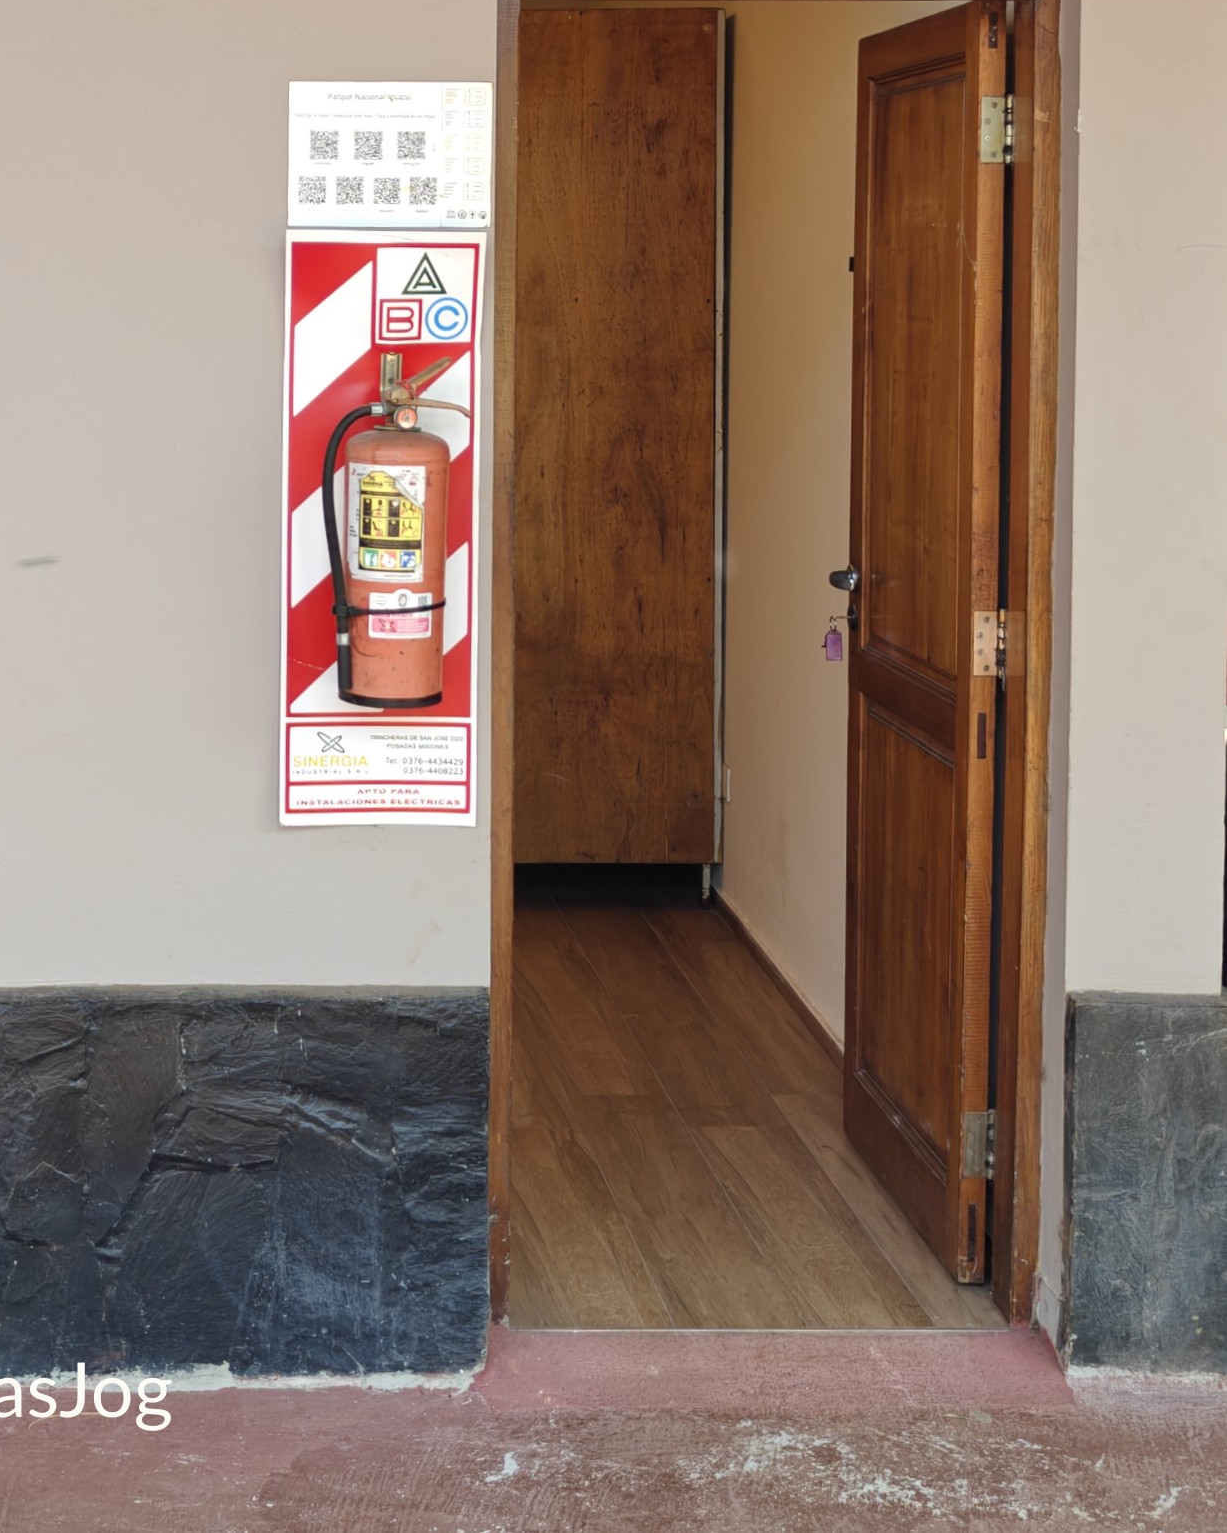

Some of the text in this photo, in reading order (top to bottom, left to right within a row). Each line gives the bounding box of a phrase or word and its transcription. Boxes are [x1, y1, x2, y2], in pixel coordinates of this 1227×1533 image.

[328, 93, 353, 101] Parque
[412, 267, 437, 289] A
[386, 305, 460, 333] B C
[293, 755, 368, 767] SINERGIA
[296, 798, 461, 806] INSTALACIONES ELECTRICAS
